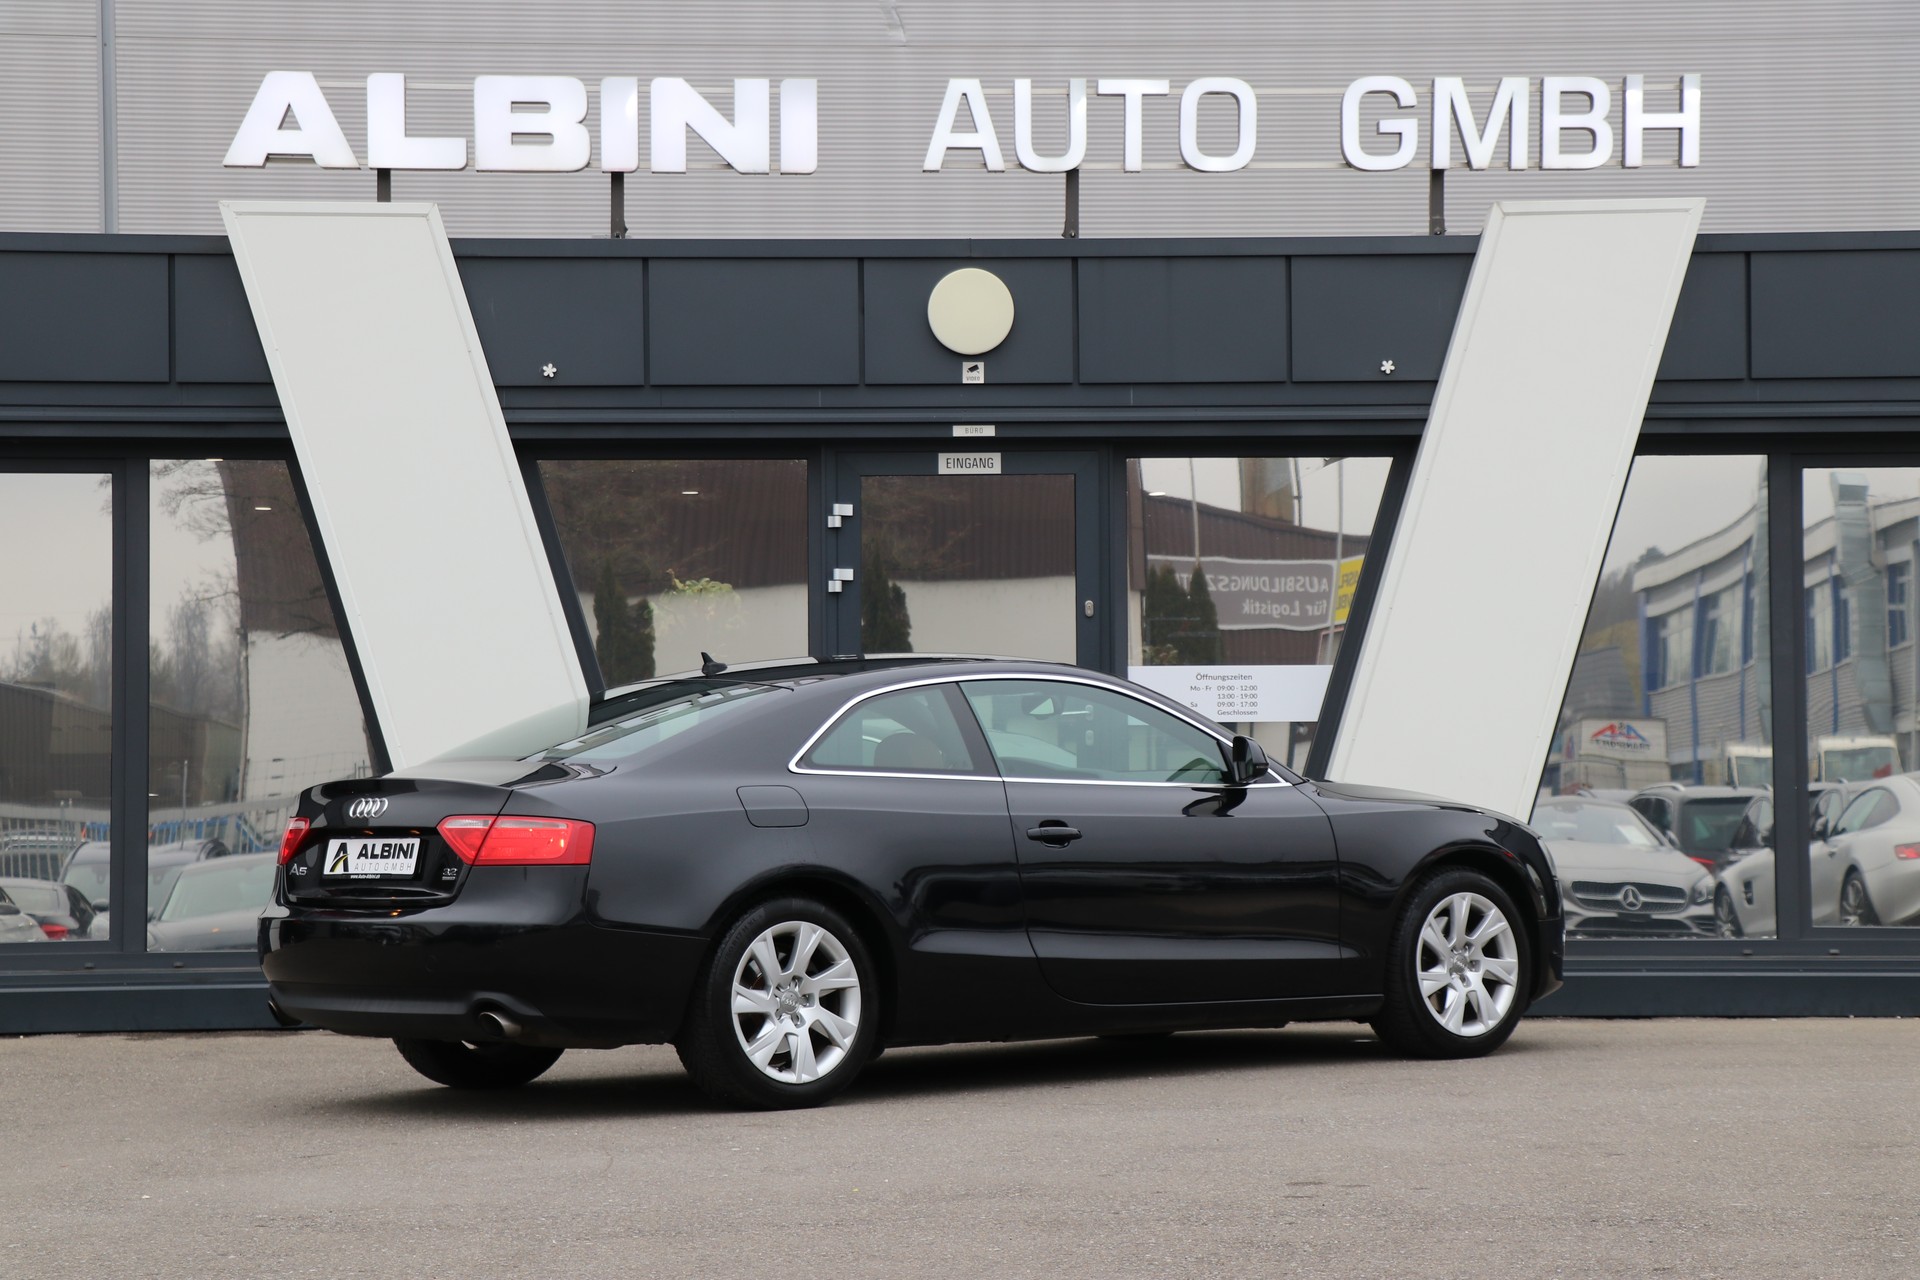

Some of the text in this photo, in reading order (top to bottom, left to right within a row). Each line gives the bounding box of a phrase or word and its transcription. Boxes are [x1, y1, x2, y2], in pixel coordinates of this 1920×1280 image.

[222, 70, 1702, 176] ALBINI AUTO GMBH
[946, 457, 994, 469] EINGANG
[1195, 672, 1253, 682] Öffnungszeiten
[356, 843, 416, 860] ALBINI
[289, 863, 308, 876] A5
[354, 862, 412, 872] AUTO GMBH
